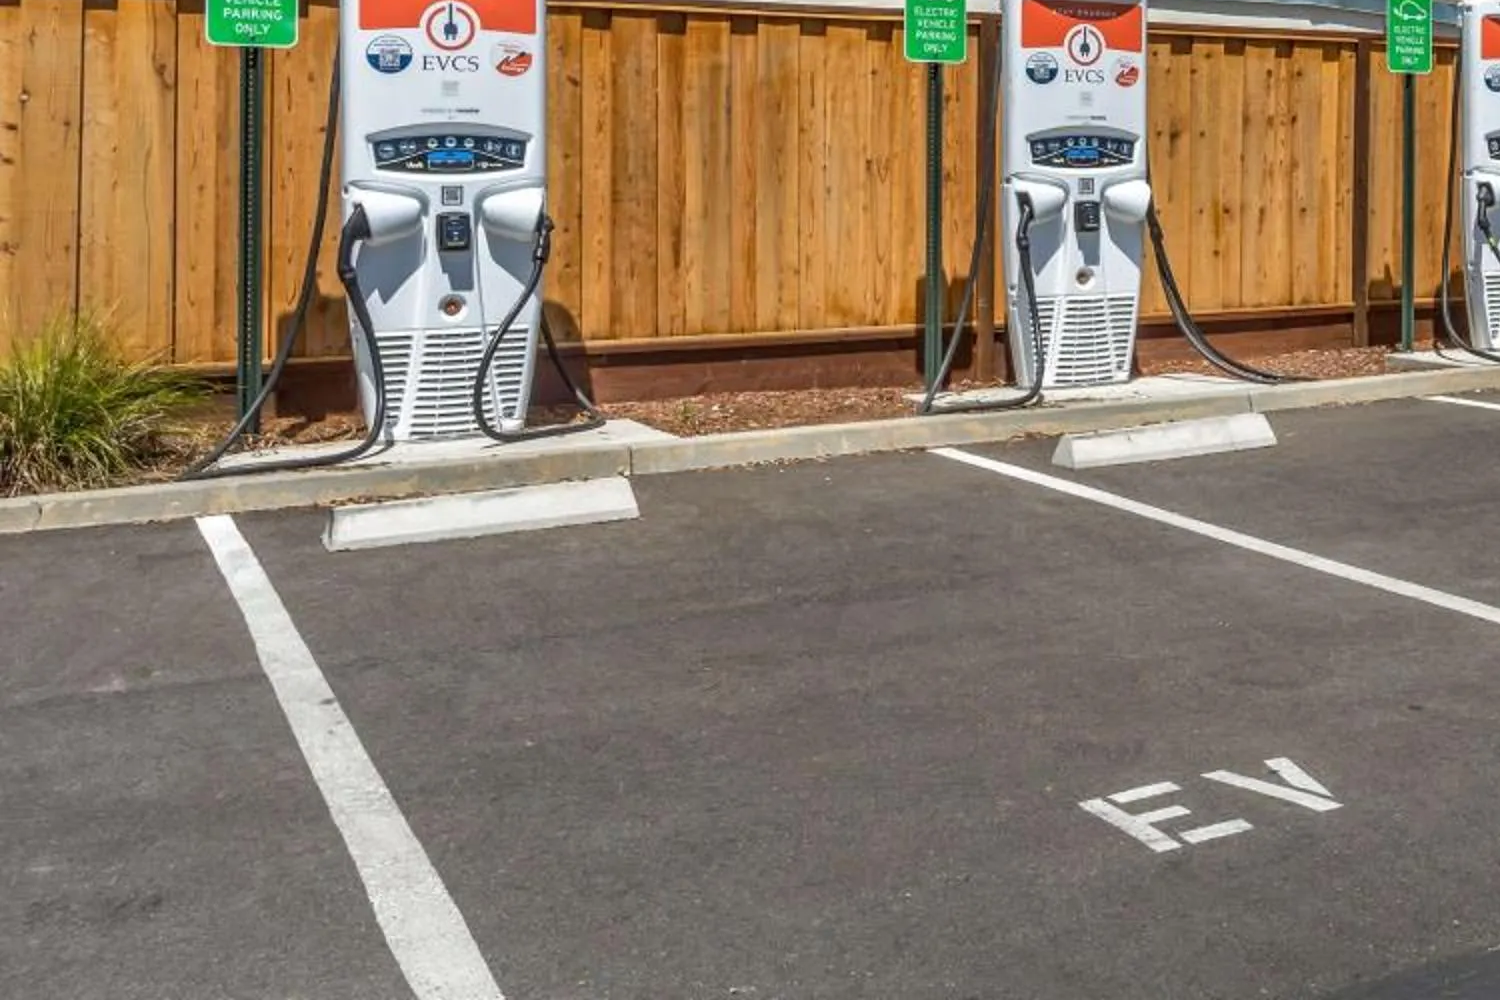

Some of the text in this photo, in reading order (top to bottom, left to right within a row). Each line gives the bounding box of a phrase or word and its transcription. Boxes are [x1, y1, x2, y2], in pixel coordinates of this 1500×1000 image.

[223, 7, 284, 21] PARKING
[913, 6, 958, 18] ELECTRIC
[235, 22, 271, 36] ONLY
[917, 19, 957, 29] VEHICLE
[916, 30, 957, 41] PARKING
[422, 55, 480, 72] EVCS
[1065, 69, 1105, 83] EVCS
[1078, 756, 1346, 853] EV
